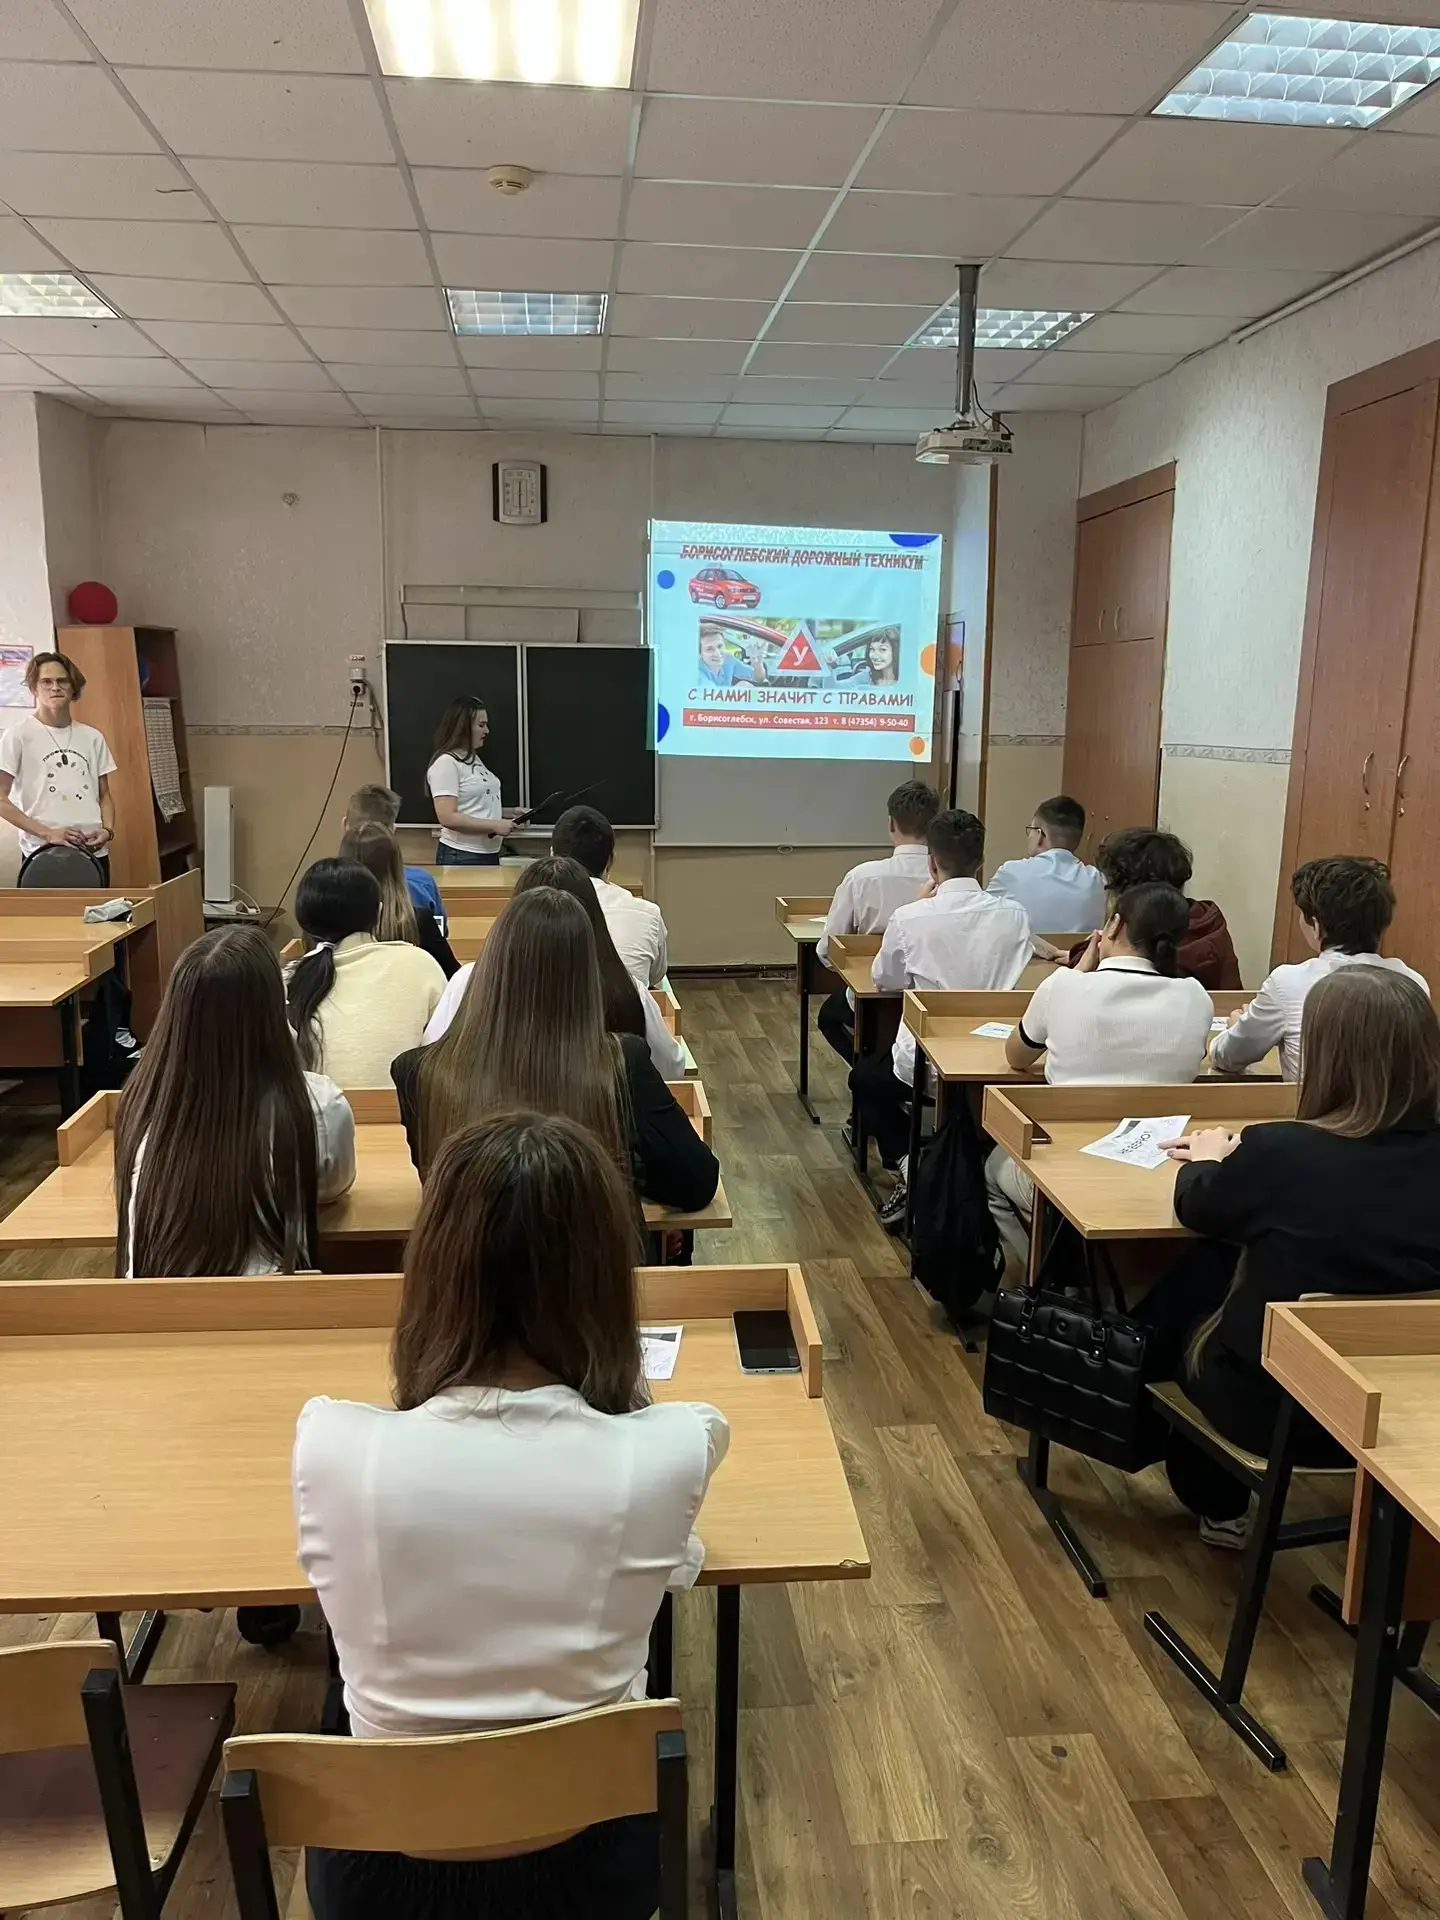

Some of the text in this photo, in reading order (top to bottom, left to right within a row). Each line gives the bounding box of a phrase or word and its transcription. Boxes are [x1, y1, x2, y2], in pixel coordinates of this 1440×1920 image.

[680, 545, 924, 570] БОРИСОГЛЕБСКИЙ ДОРОЖНЫЙ ТЕХНИКУМ
[792, 646, 809, 666] У
[688, 688, 697, 701] С
[757, 690, 818, 704] ЗНАЧИТ
[822, 692, 833, 704] С
[697, 713, 757, 725] Борисоглебск,
[758, 717, 771, 725] ул.
[814, 716, 829, 726] 123
[847, 717, 877, 727] (47354)
[879, 718, 909, 727] 9-50-40
